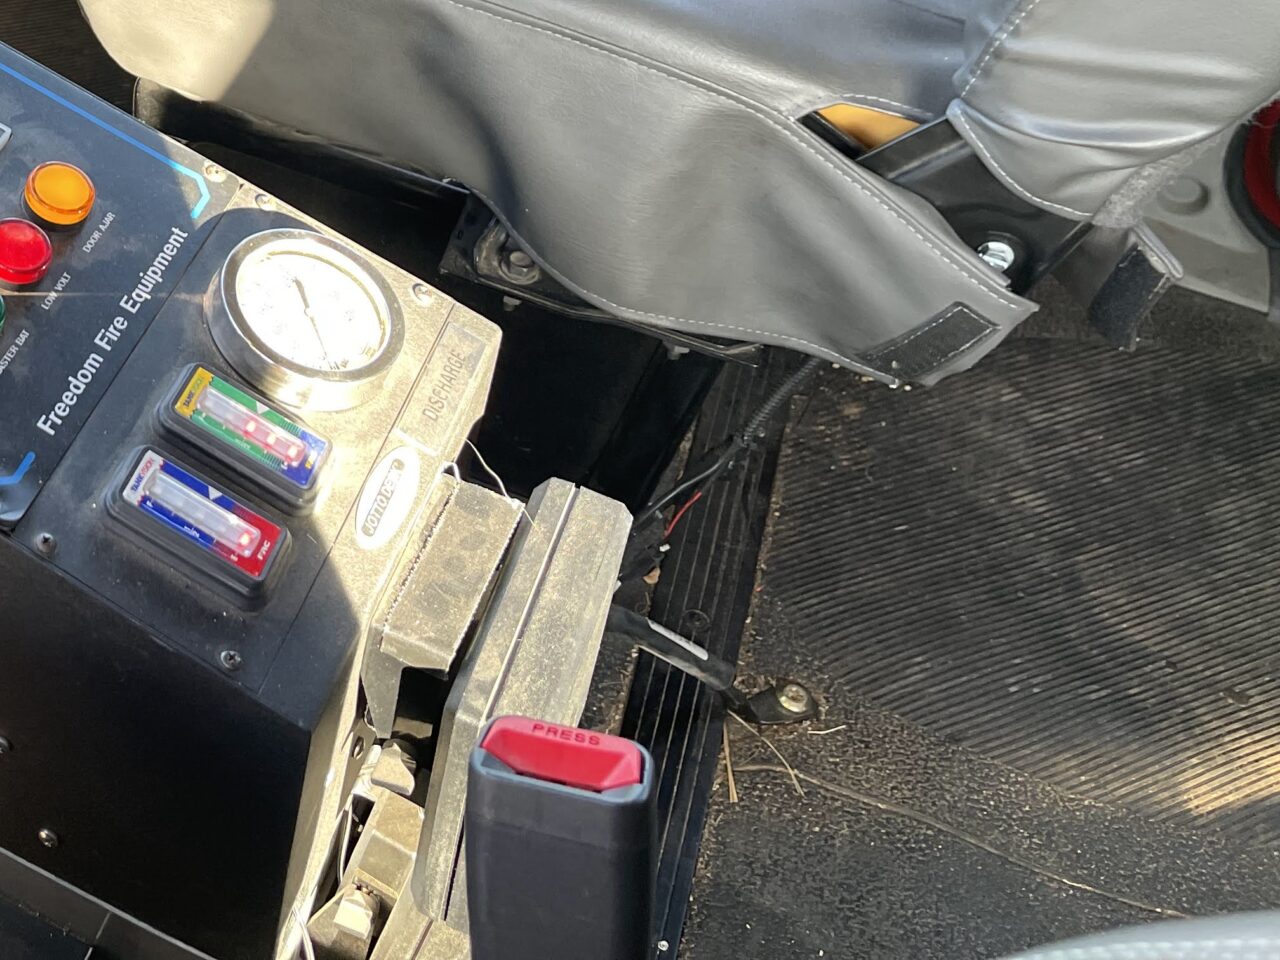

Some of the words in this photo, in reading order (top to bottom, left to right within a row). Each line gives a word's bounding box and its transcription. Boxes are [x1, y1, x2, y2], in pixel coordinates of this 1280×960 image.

[82, 231, 101, 254] DOOR
[98, 212, 116, 233] AJAR
[41, 289, 59, 311] LOW
[54, 272, 72, 294] VOLT
[16, 329, 30, 346] BAT
[37, 350, 104, 436] Freedom
[94, 315, 128, 352] Fire
[120, 226, 189, 314] Equipment
[422, 350, 466, 421] DISCHARGE
[364, 494, 388, 534] JOTTO
[532, 723, 601, 746] PRESS
